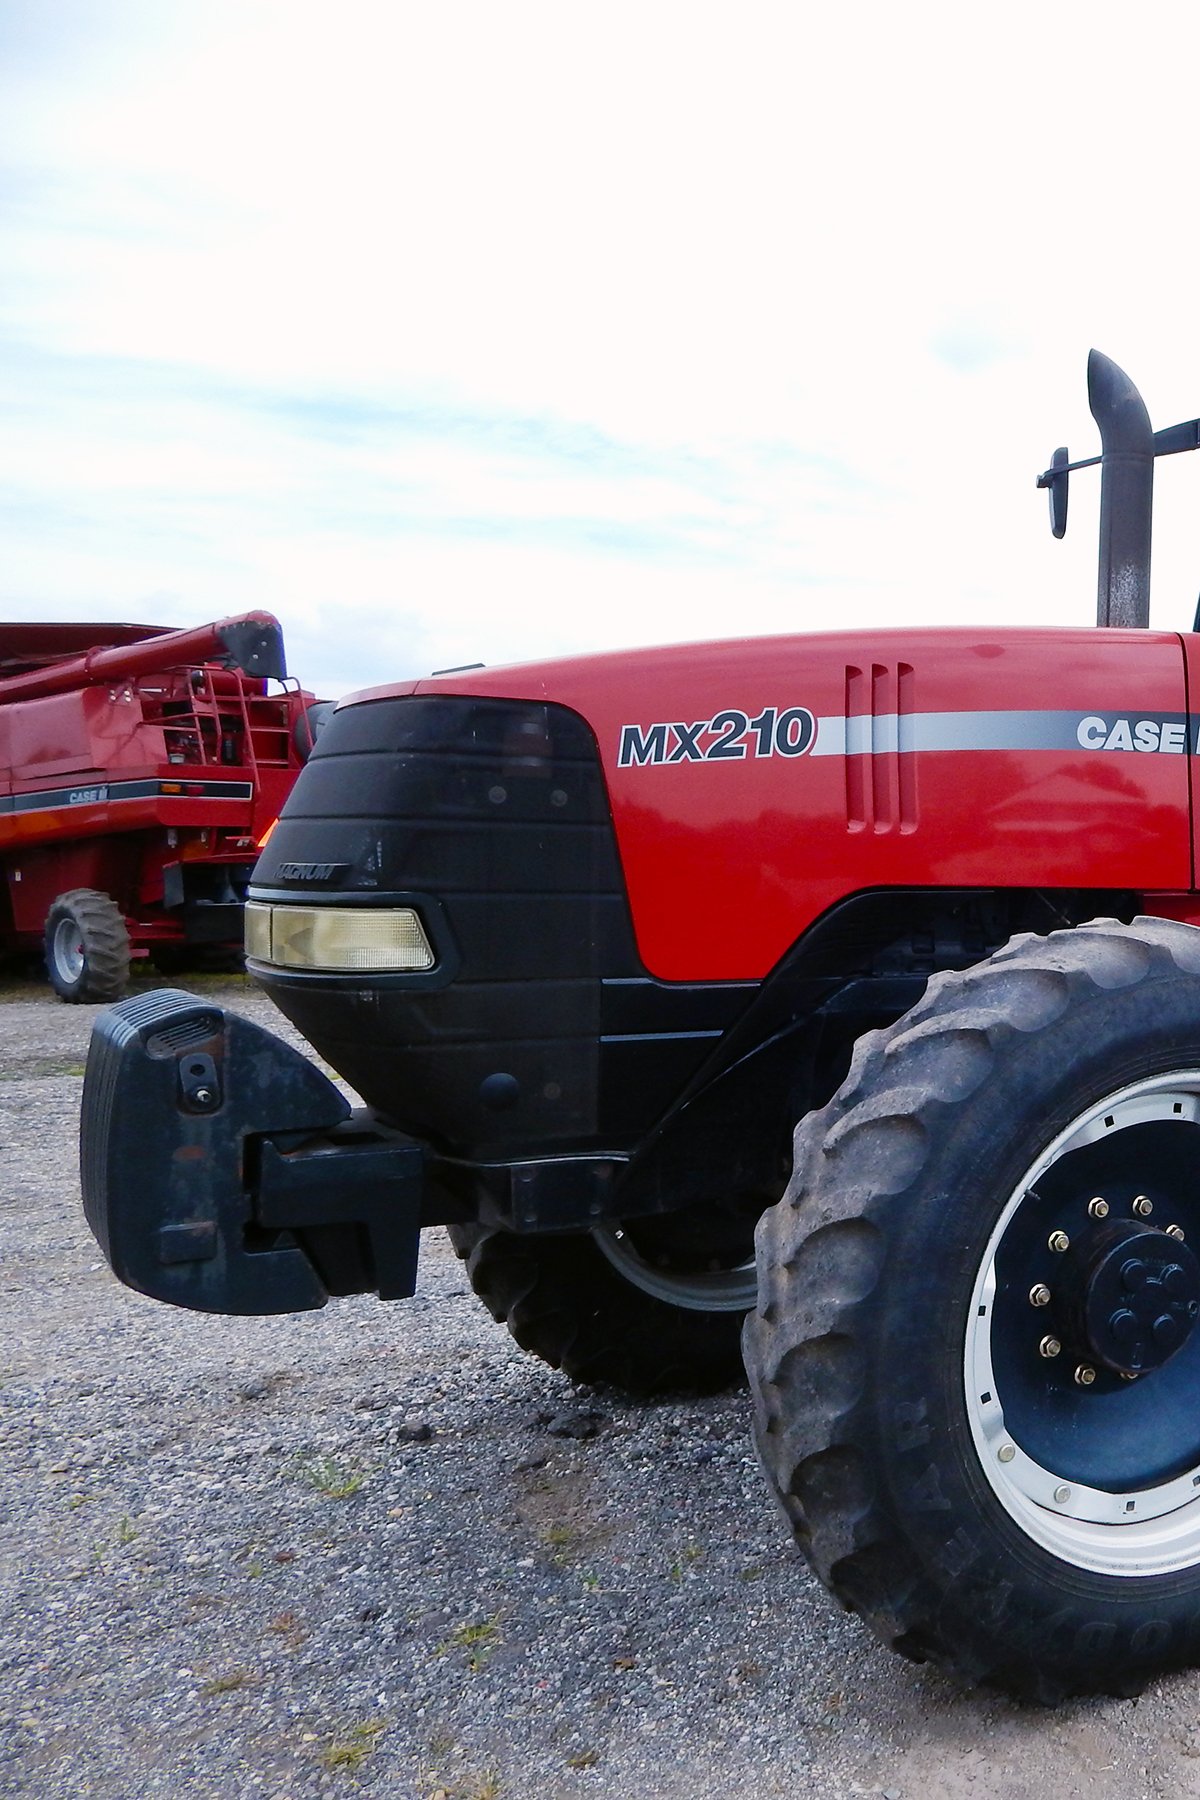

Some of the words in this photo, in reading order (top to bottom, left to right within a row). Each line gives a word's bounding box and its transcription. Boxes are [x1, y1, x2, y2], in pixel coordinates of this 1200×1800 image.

[617, 706, 816, 768] MX210
[1076, 716, 1186, 754] CASE
[69, 790, 97, 803] CASE
[273, 864, 334, 880] MAGNUM
